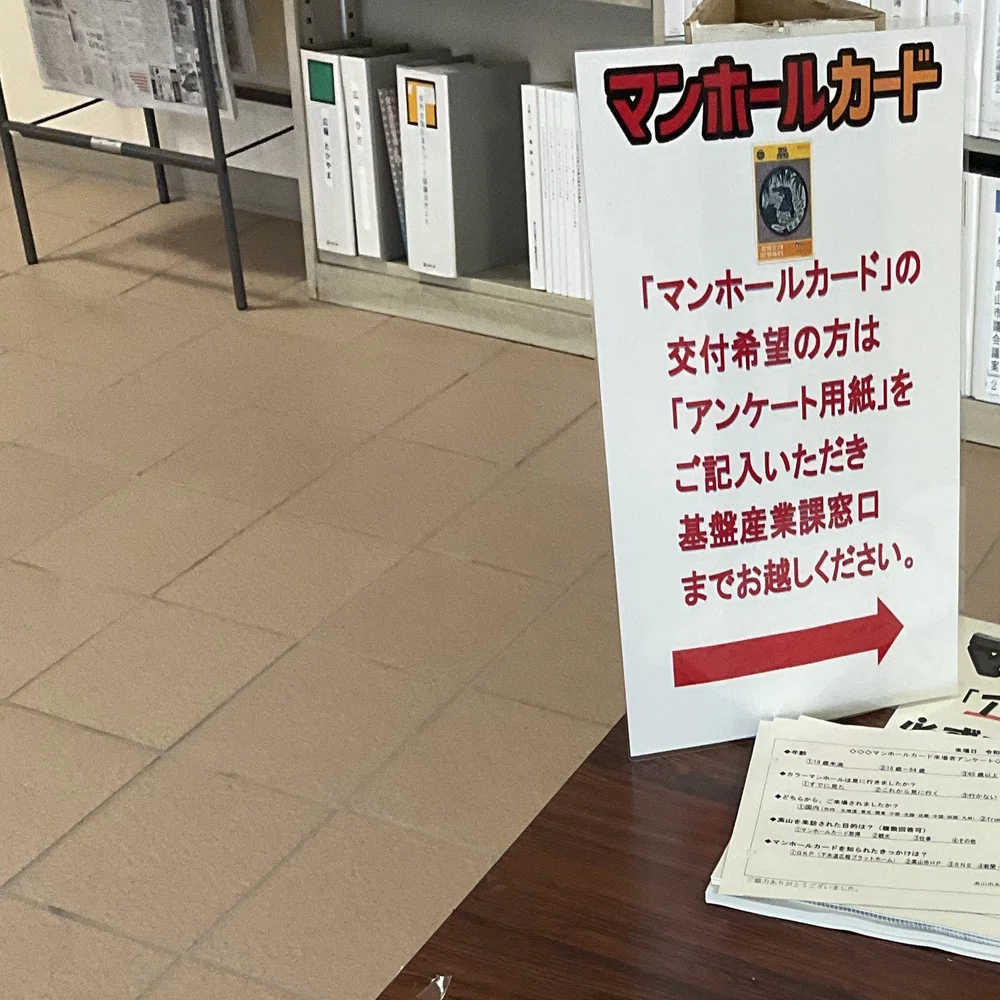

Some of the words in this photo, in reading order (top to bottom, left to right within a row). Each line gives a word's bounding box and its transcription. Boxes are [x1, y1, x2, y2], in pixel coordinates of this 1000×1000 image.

[604, 41, 942, 145] マンホールカード
[641, 250, 921, 312] 「マンホールカード」の
[667, 315, 880, 377] 交付希望の方は
[672, 368, 914, 435] 「アンケート用紙」を
[676, 434, 868, 493] ご記入いただき
[678, 490, 879, 551] 基盤産業課窓口
[681, 542, 914, 606] までお越しください。
